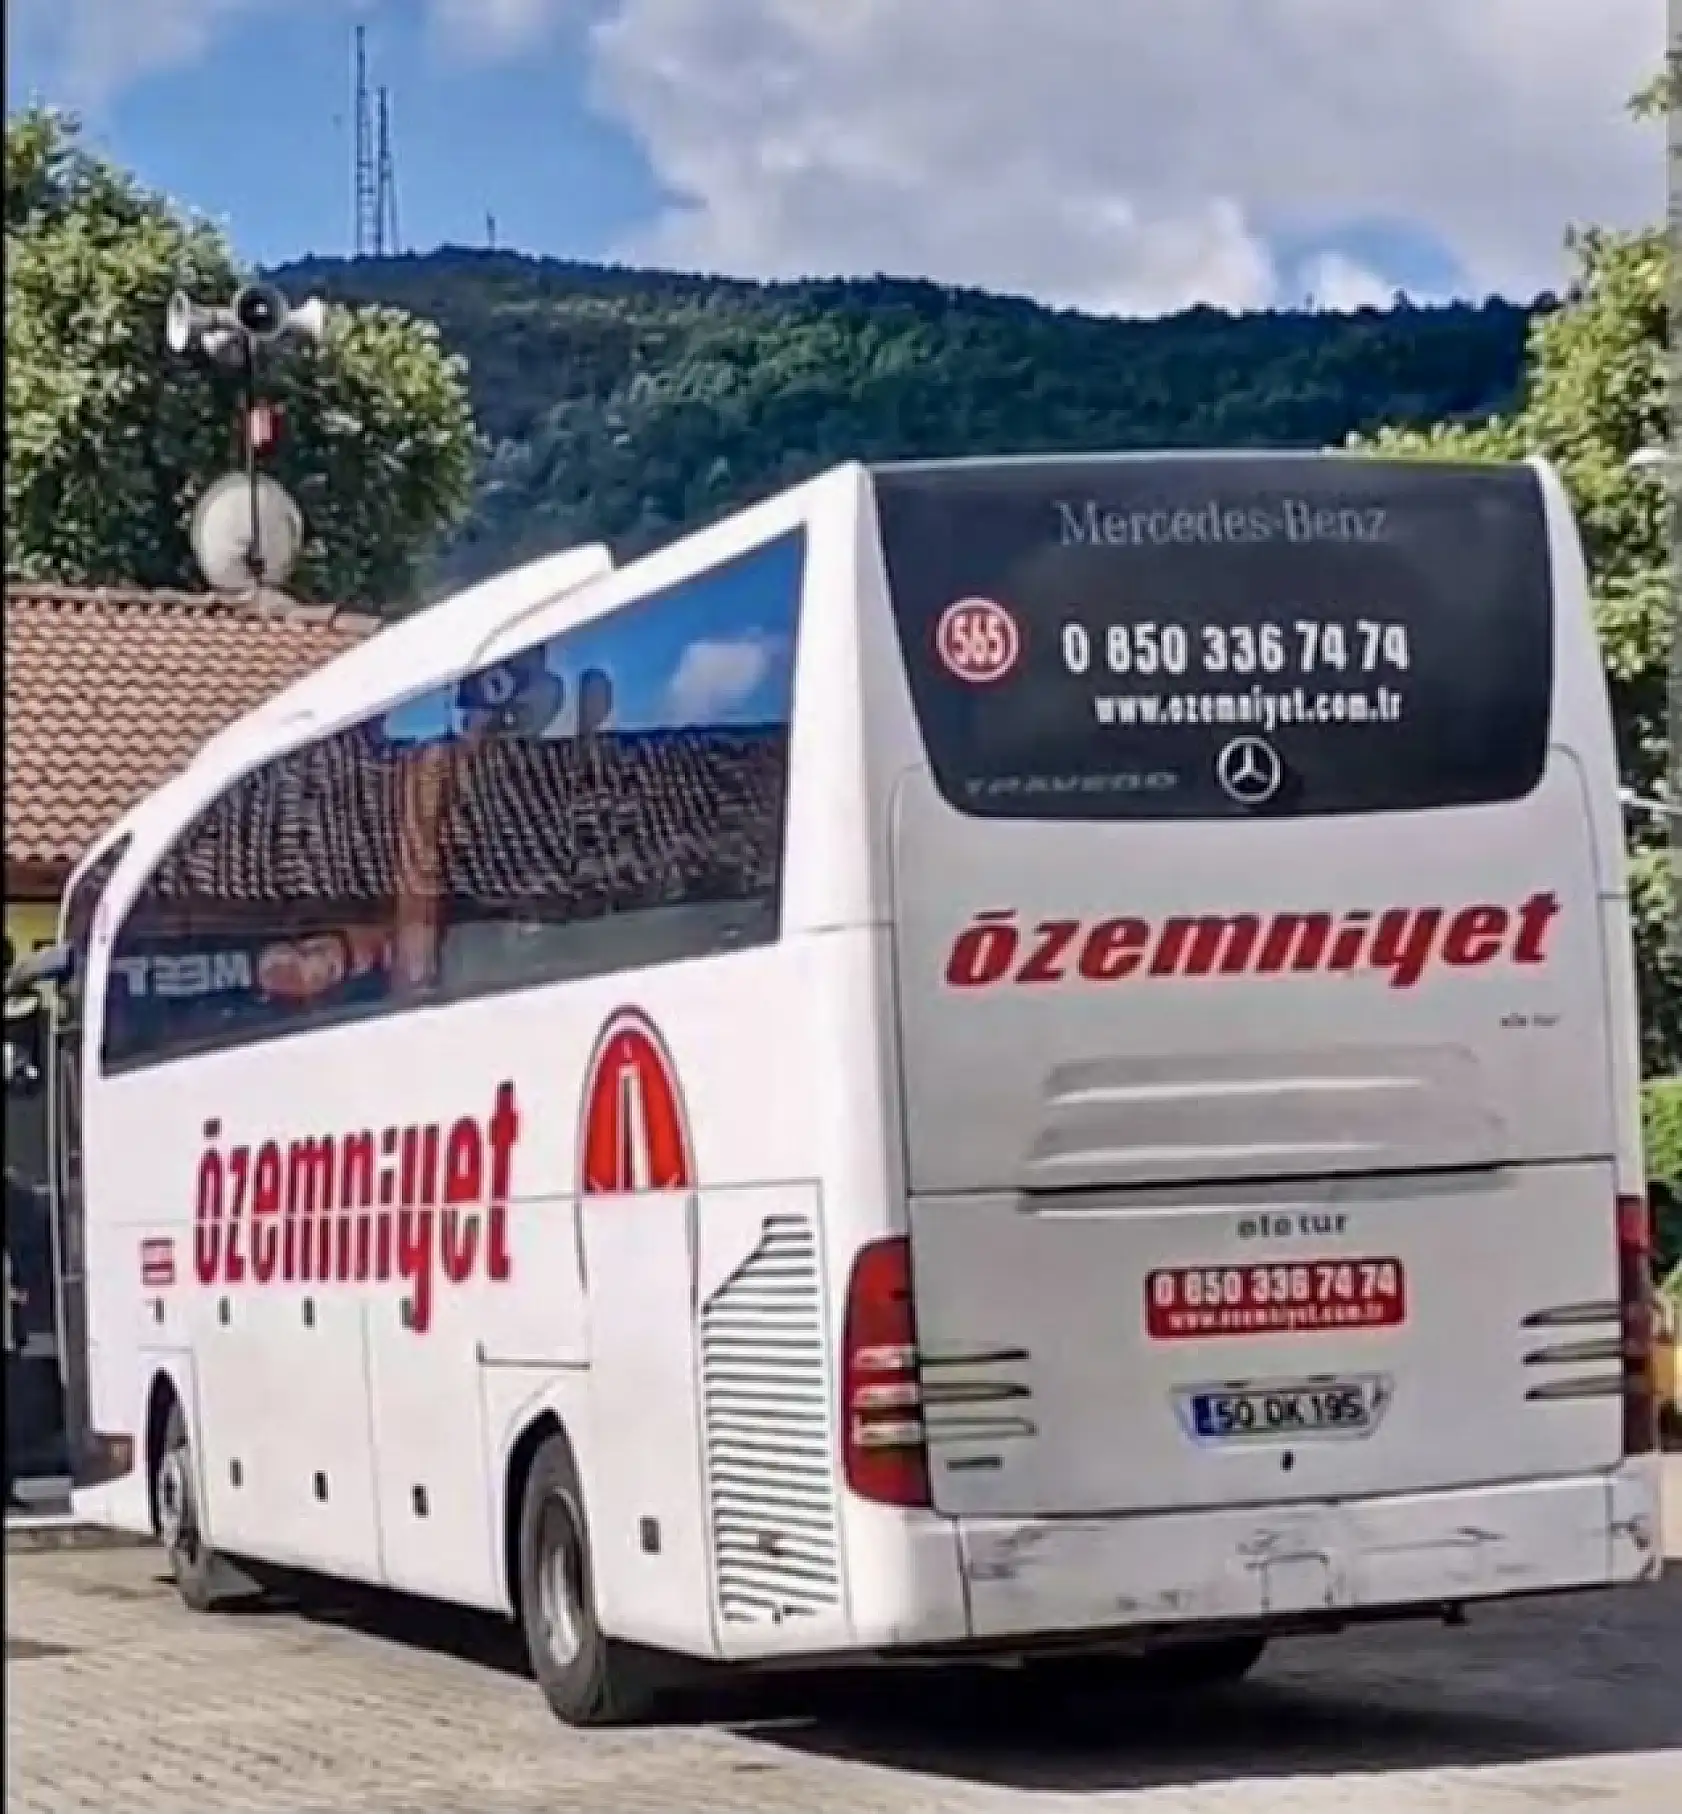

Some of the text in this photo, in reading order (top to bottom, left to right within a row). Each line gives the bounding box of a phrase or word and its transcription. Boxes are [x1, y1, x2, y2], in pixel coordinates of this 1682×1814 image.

[1057, 499, 1388, 547] Mercedes-Benz
[950, 613, 1004, 665] 565
[1062, 619, 1411, 674] 0 850 336 74 74
[1155, 1272, 1177, 1307] 0
[1184, 1269, 1243, 1306] 850
[1316, 1264, 1354, 1300] 74
[1360, 1261, 1398, 1298] 74
